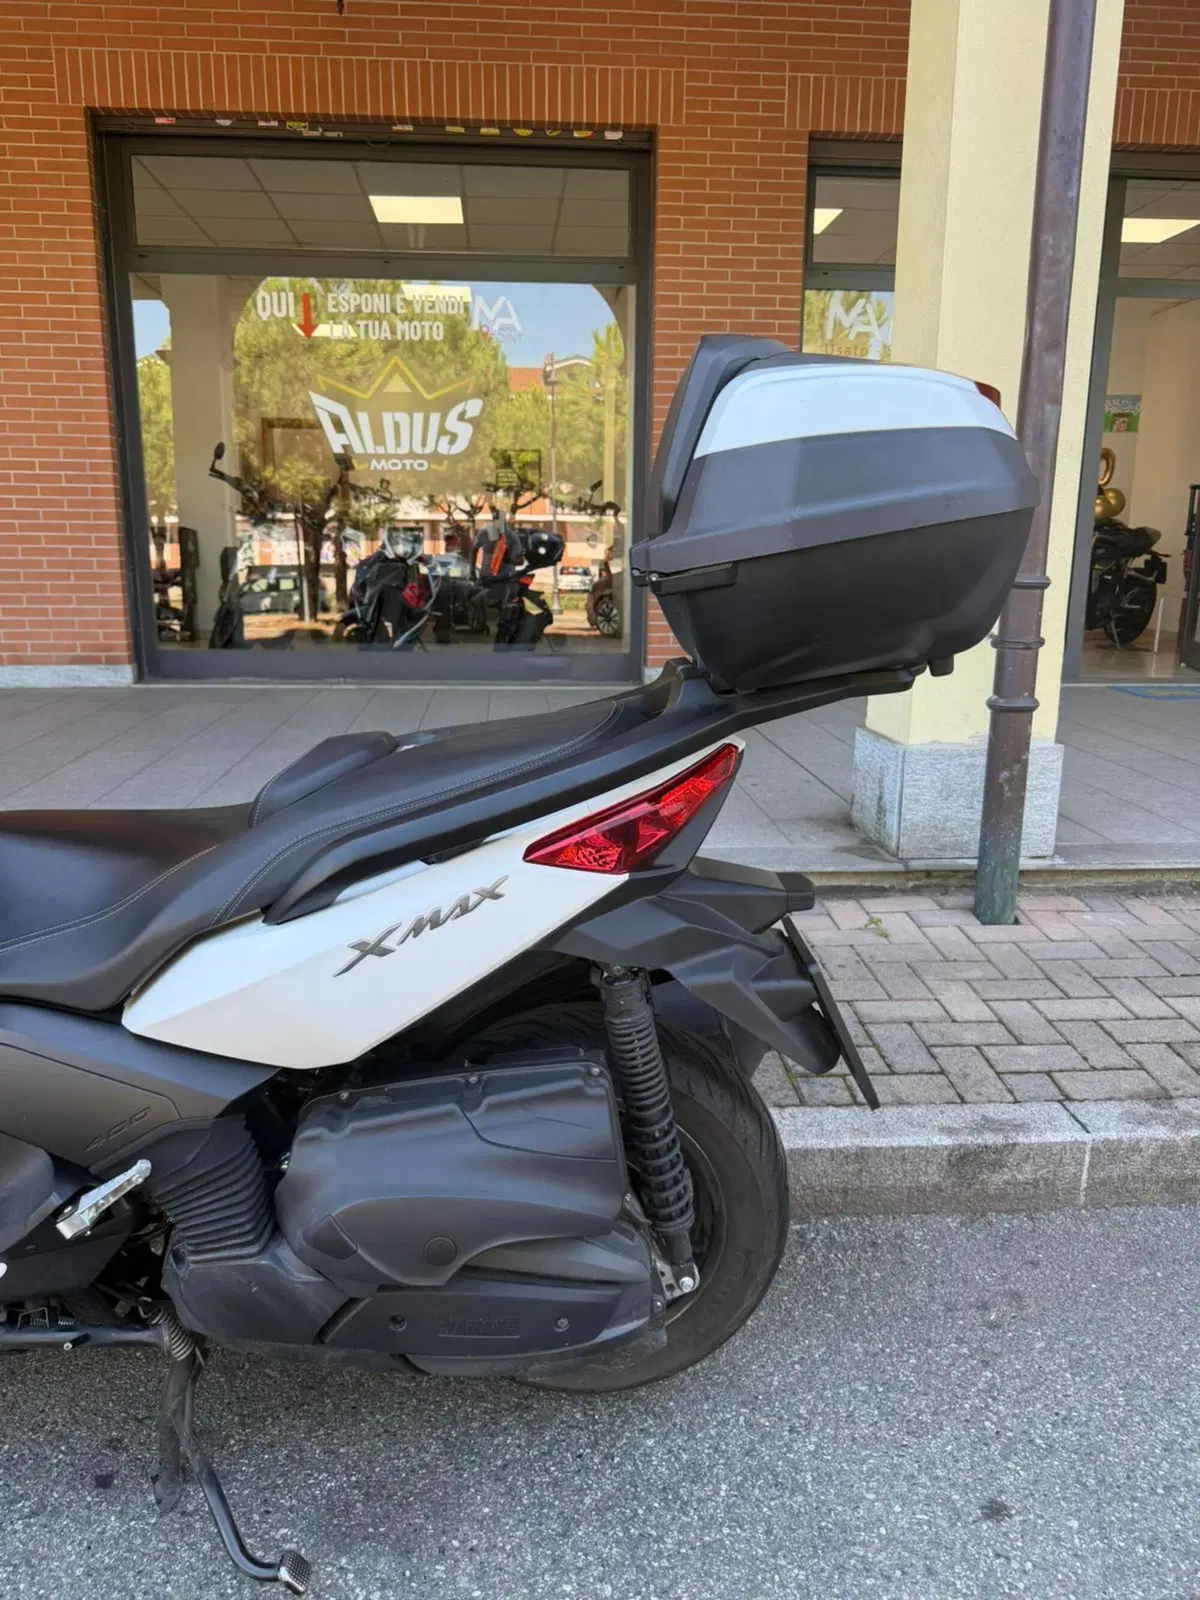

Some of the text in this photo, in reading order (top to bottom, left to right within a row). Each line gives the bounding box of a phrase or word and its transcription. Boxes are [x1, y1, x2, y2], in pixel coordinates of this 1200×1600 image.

[256, 291, 295, 320] QUI
[327, 293, 464, 314] ESPONI E VENDI
[329, 320, 444, 341] LA TUA MOTO
[308, 391, 483, 455] ALDUS
[369, 459, 428, 471] MOTO
